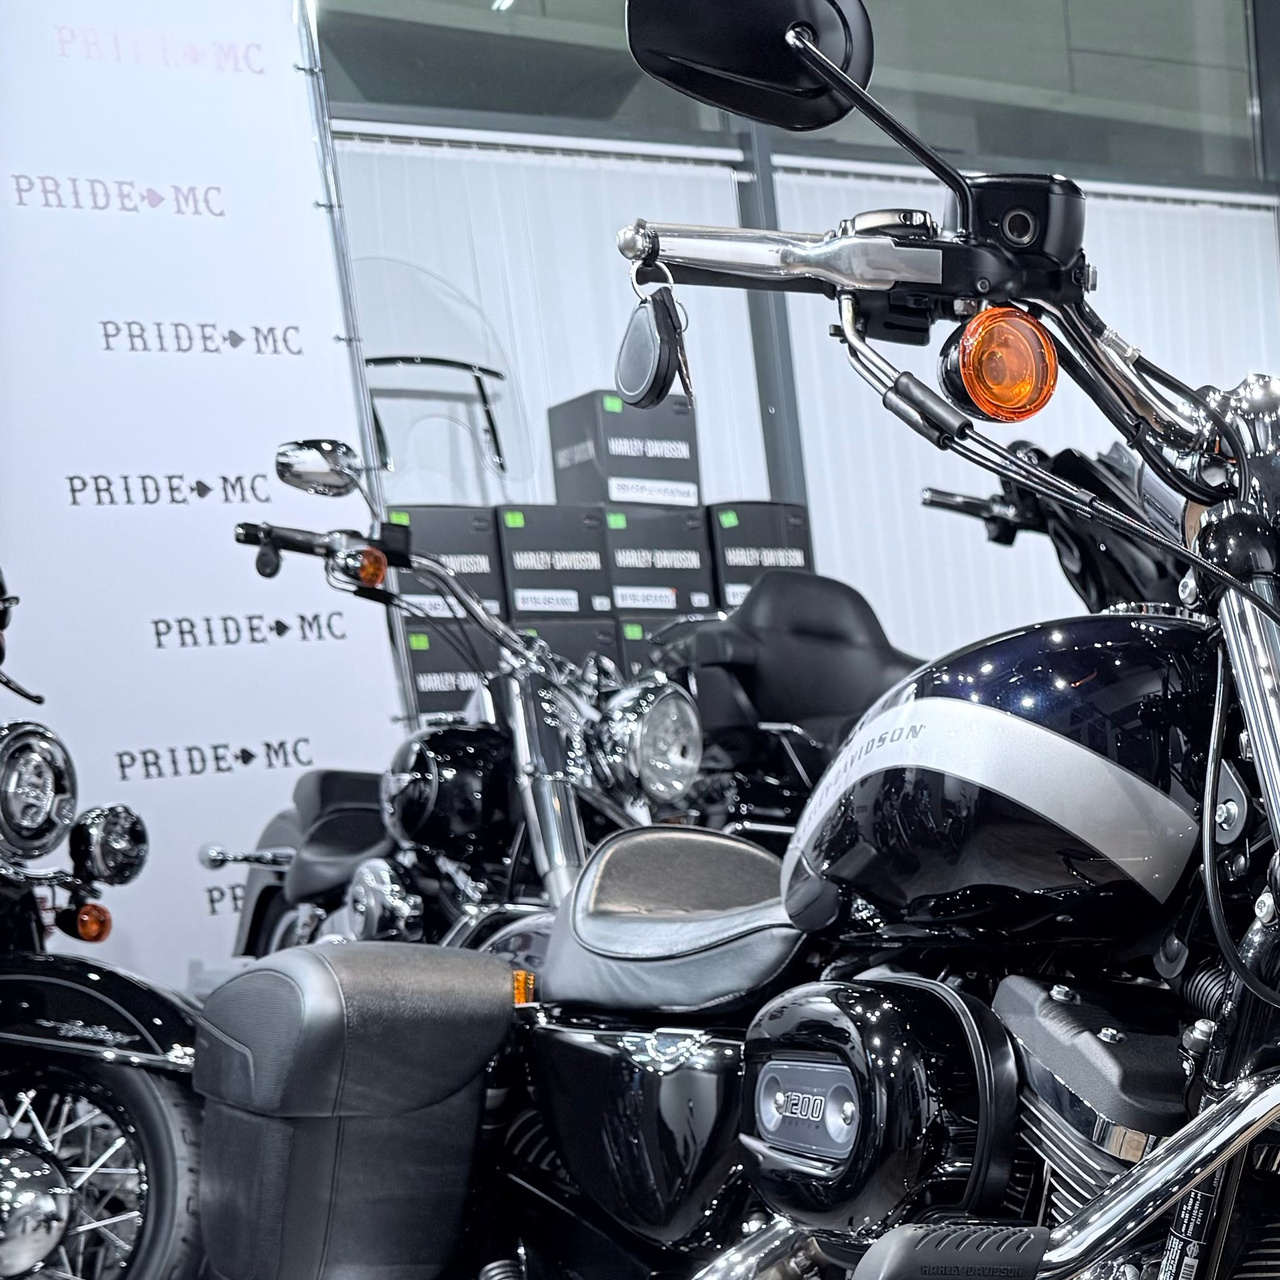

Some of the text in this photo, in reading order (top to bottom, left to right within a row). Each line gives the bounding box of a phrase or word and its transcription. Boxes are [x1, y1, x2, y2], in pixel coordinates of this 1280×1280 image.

[54, 25, 267, 75] PRI MC
[11, 174, 226, 217] PRIDE MC
[99, 320, 304, 356] PRIDE MC
[607, 437, 690, 459] HARLEY-DAVIDSON
[65, 474, 272, 506] PRIDE MC
[512, 550, 601, 570] HARLEY-DAVIDSON
[614, 549, 700, 569] HARLEY-DAVIDSON
[724, 547, 805, 567] HARLEY-DAVIDSON
[151, 612, 347, 648] PRIDE MC
[116, 738, 314, 781] PRIDE MC
[783, 1091, 825, 1121] 1200
[920, 1264, 1023, 1279] HARLEY-DAVIDSON
